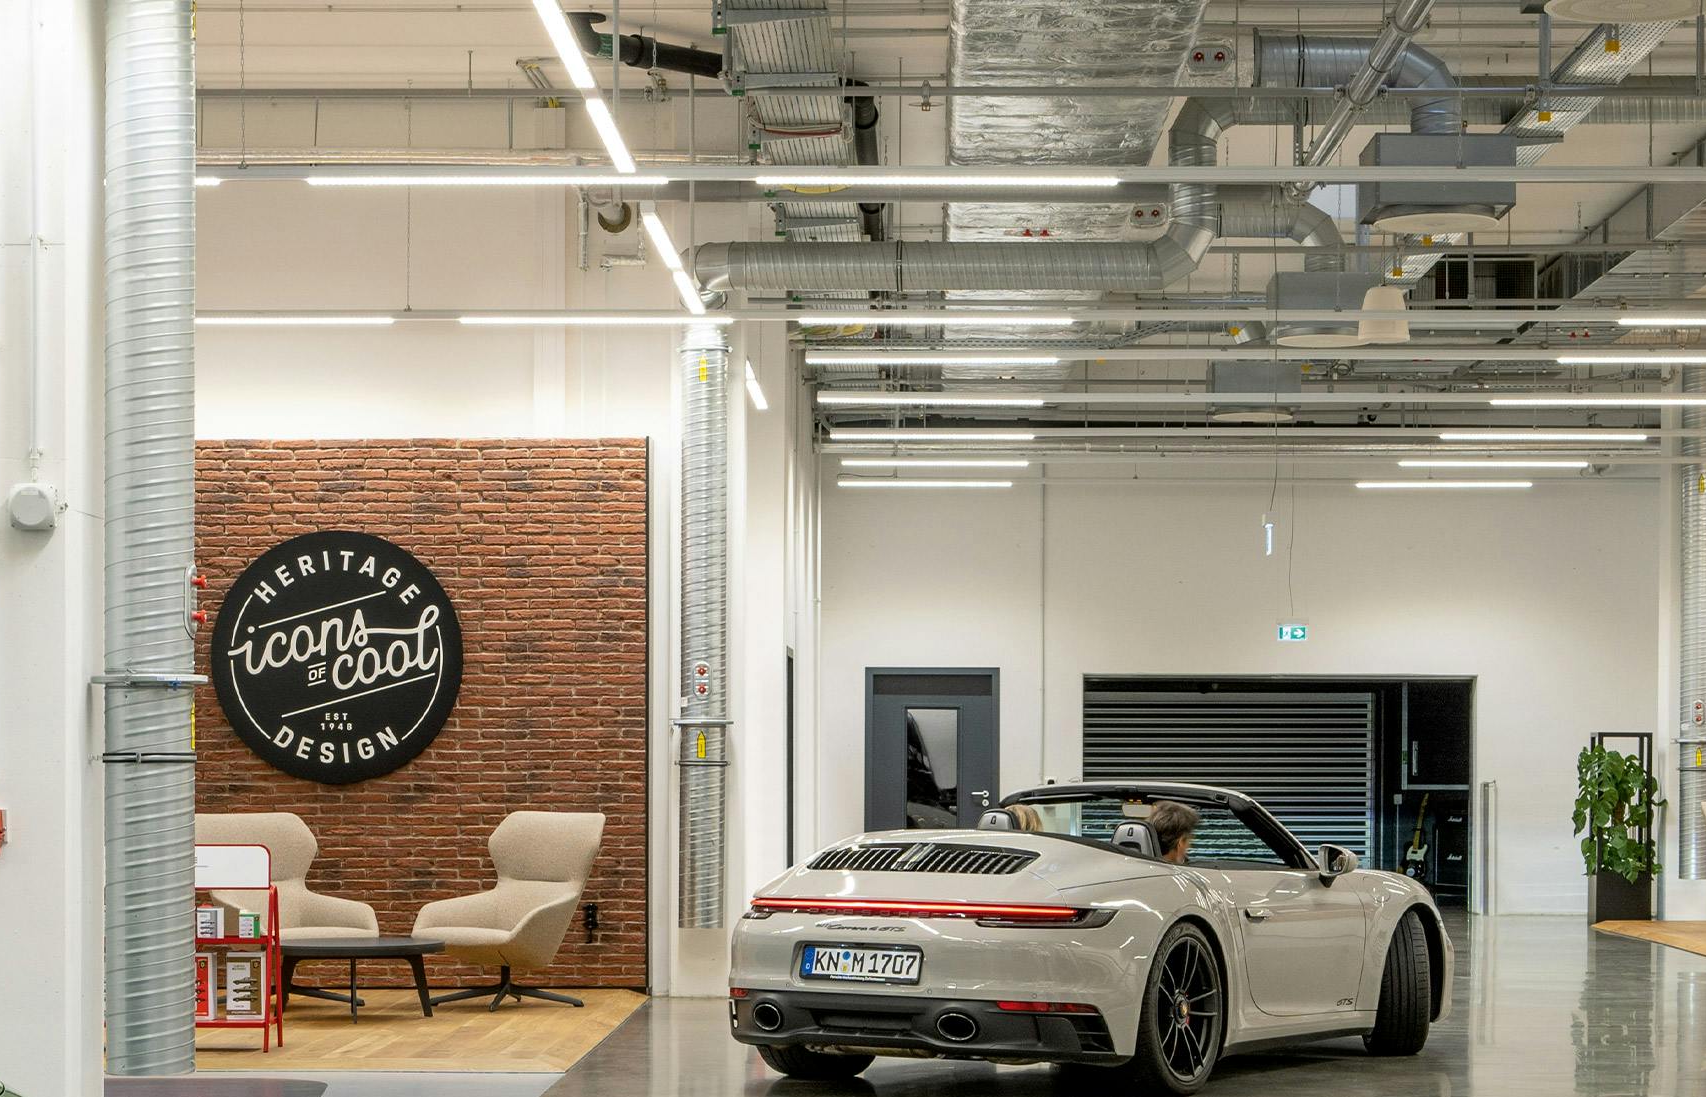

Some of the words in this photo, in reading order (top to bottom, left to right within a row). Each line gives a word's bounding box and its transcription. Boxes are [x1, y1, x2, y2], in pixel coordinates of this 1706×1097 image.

[254, 551, 420, 604] HERITAGE
[228, 609, 370, 674] icons
[308, 666, 326, 681] OF
[332, 605, 440, 690] cool
[321, 723, 353, 731] 1948
[325, 713, 348, 721] EST
[273, 725, 399, 764] DESIGN
[814, 951, 840, 972] KN
[851, 954, 864, 973] M
[867, 953, 918, 975] 1707
[1336, 997, 1354, 1007] GTS
